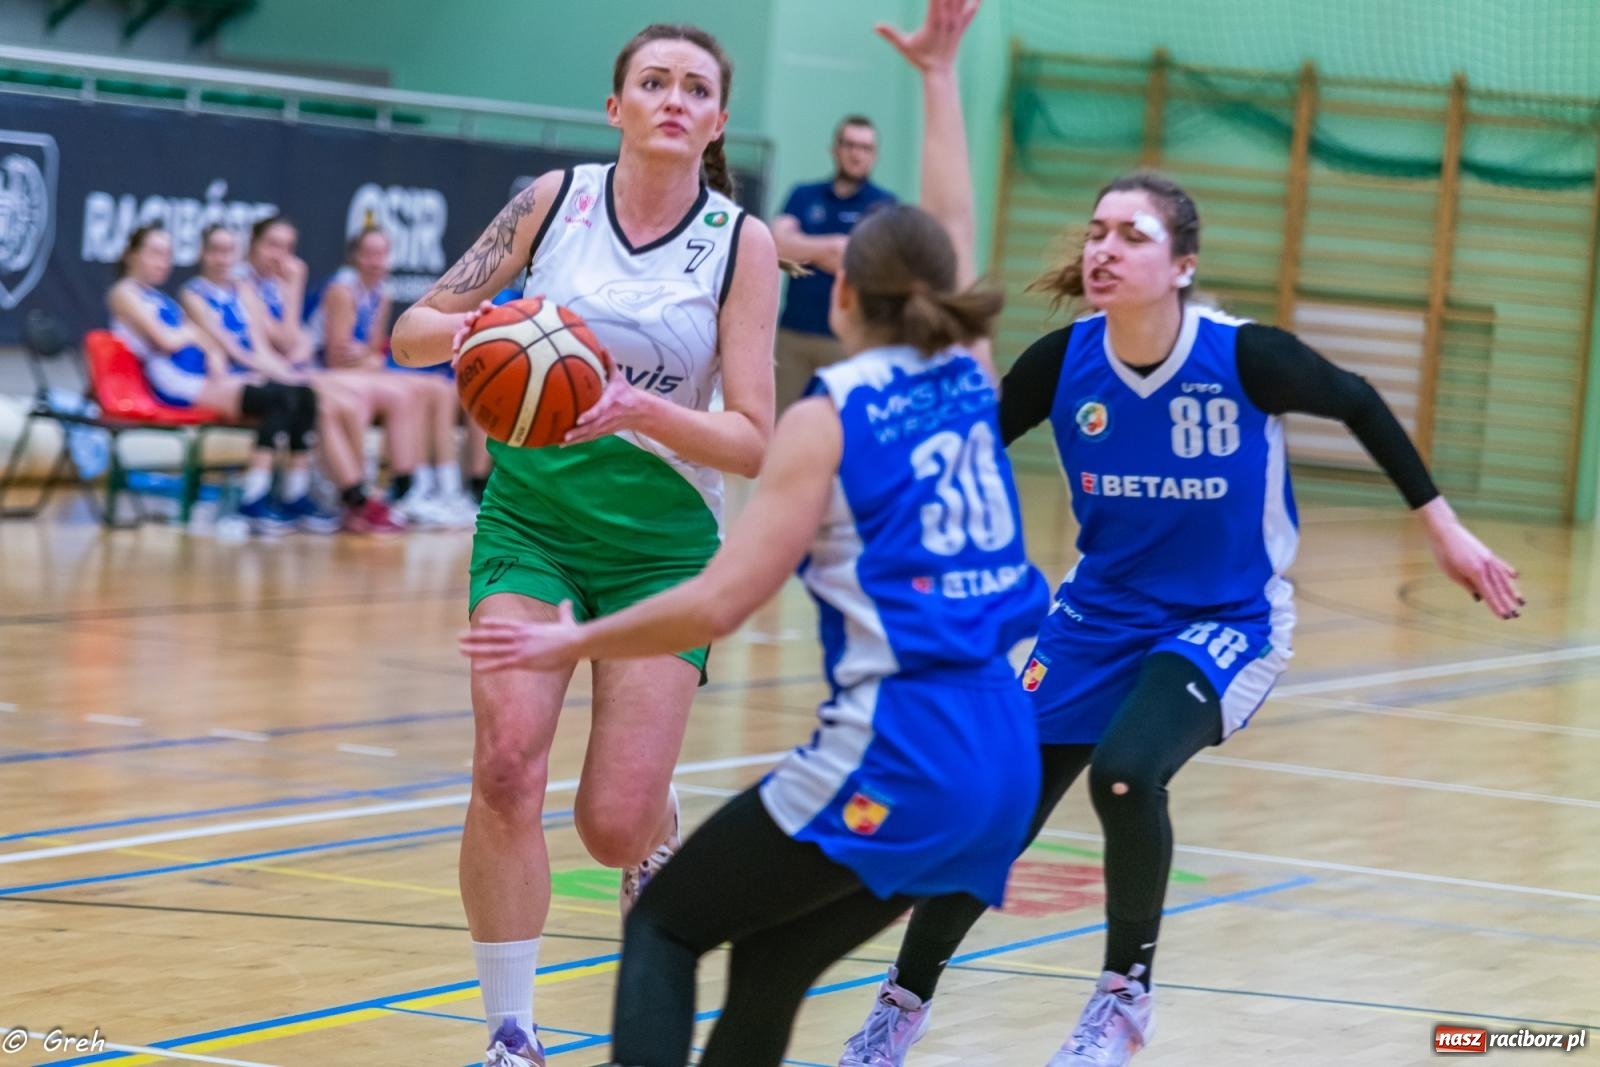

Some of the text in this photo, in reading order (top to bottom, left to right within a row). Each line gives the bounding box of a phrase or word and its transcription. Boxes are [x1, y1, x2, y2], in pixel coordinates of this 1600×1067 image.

[684, 239, 716, 273] 7
[617, 363, 684, 394] vis
[1169, 396, 1241, 458] 88
[910, 420, 1015, 556] 30
[1102, 474, 1229, 501] BETARD
[485, 555, 519, 586] 7
[1176, 621, 1249, 670] 88
